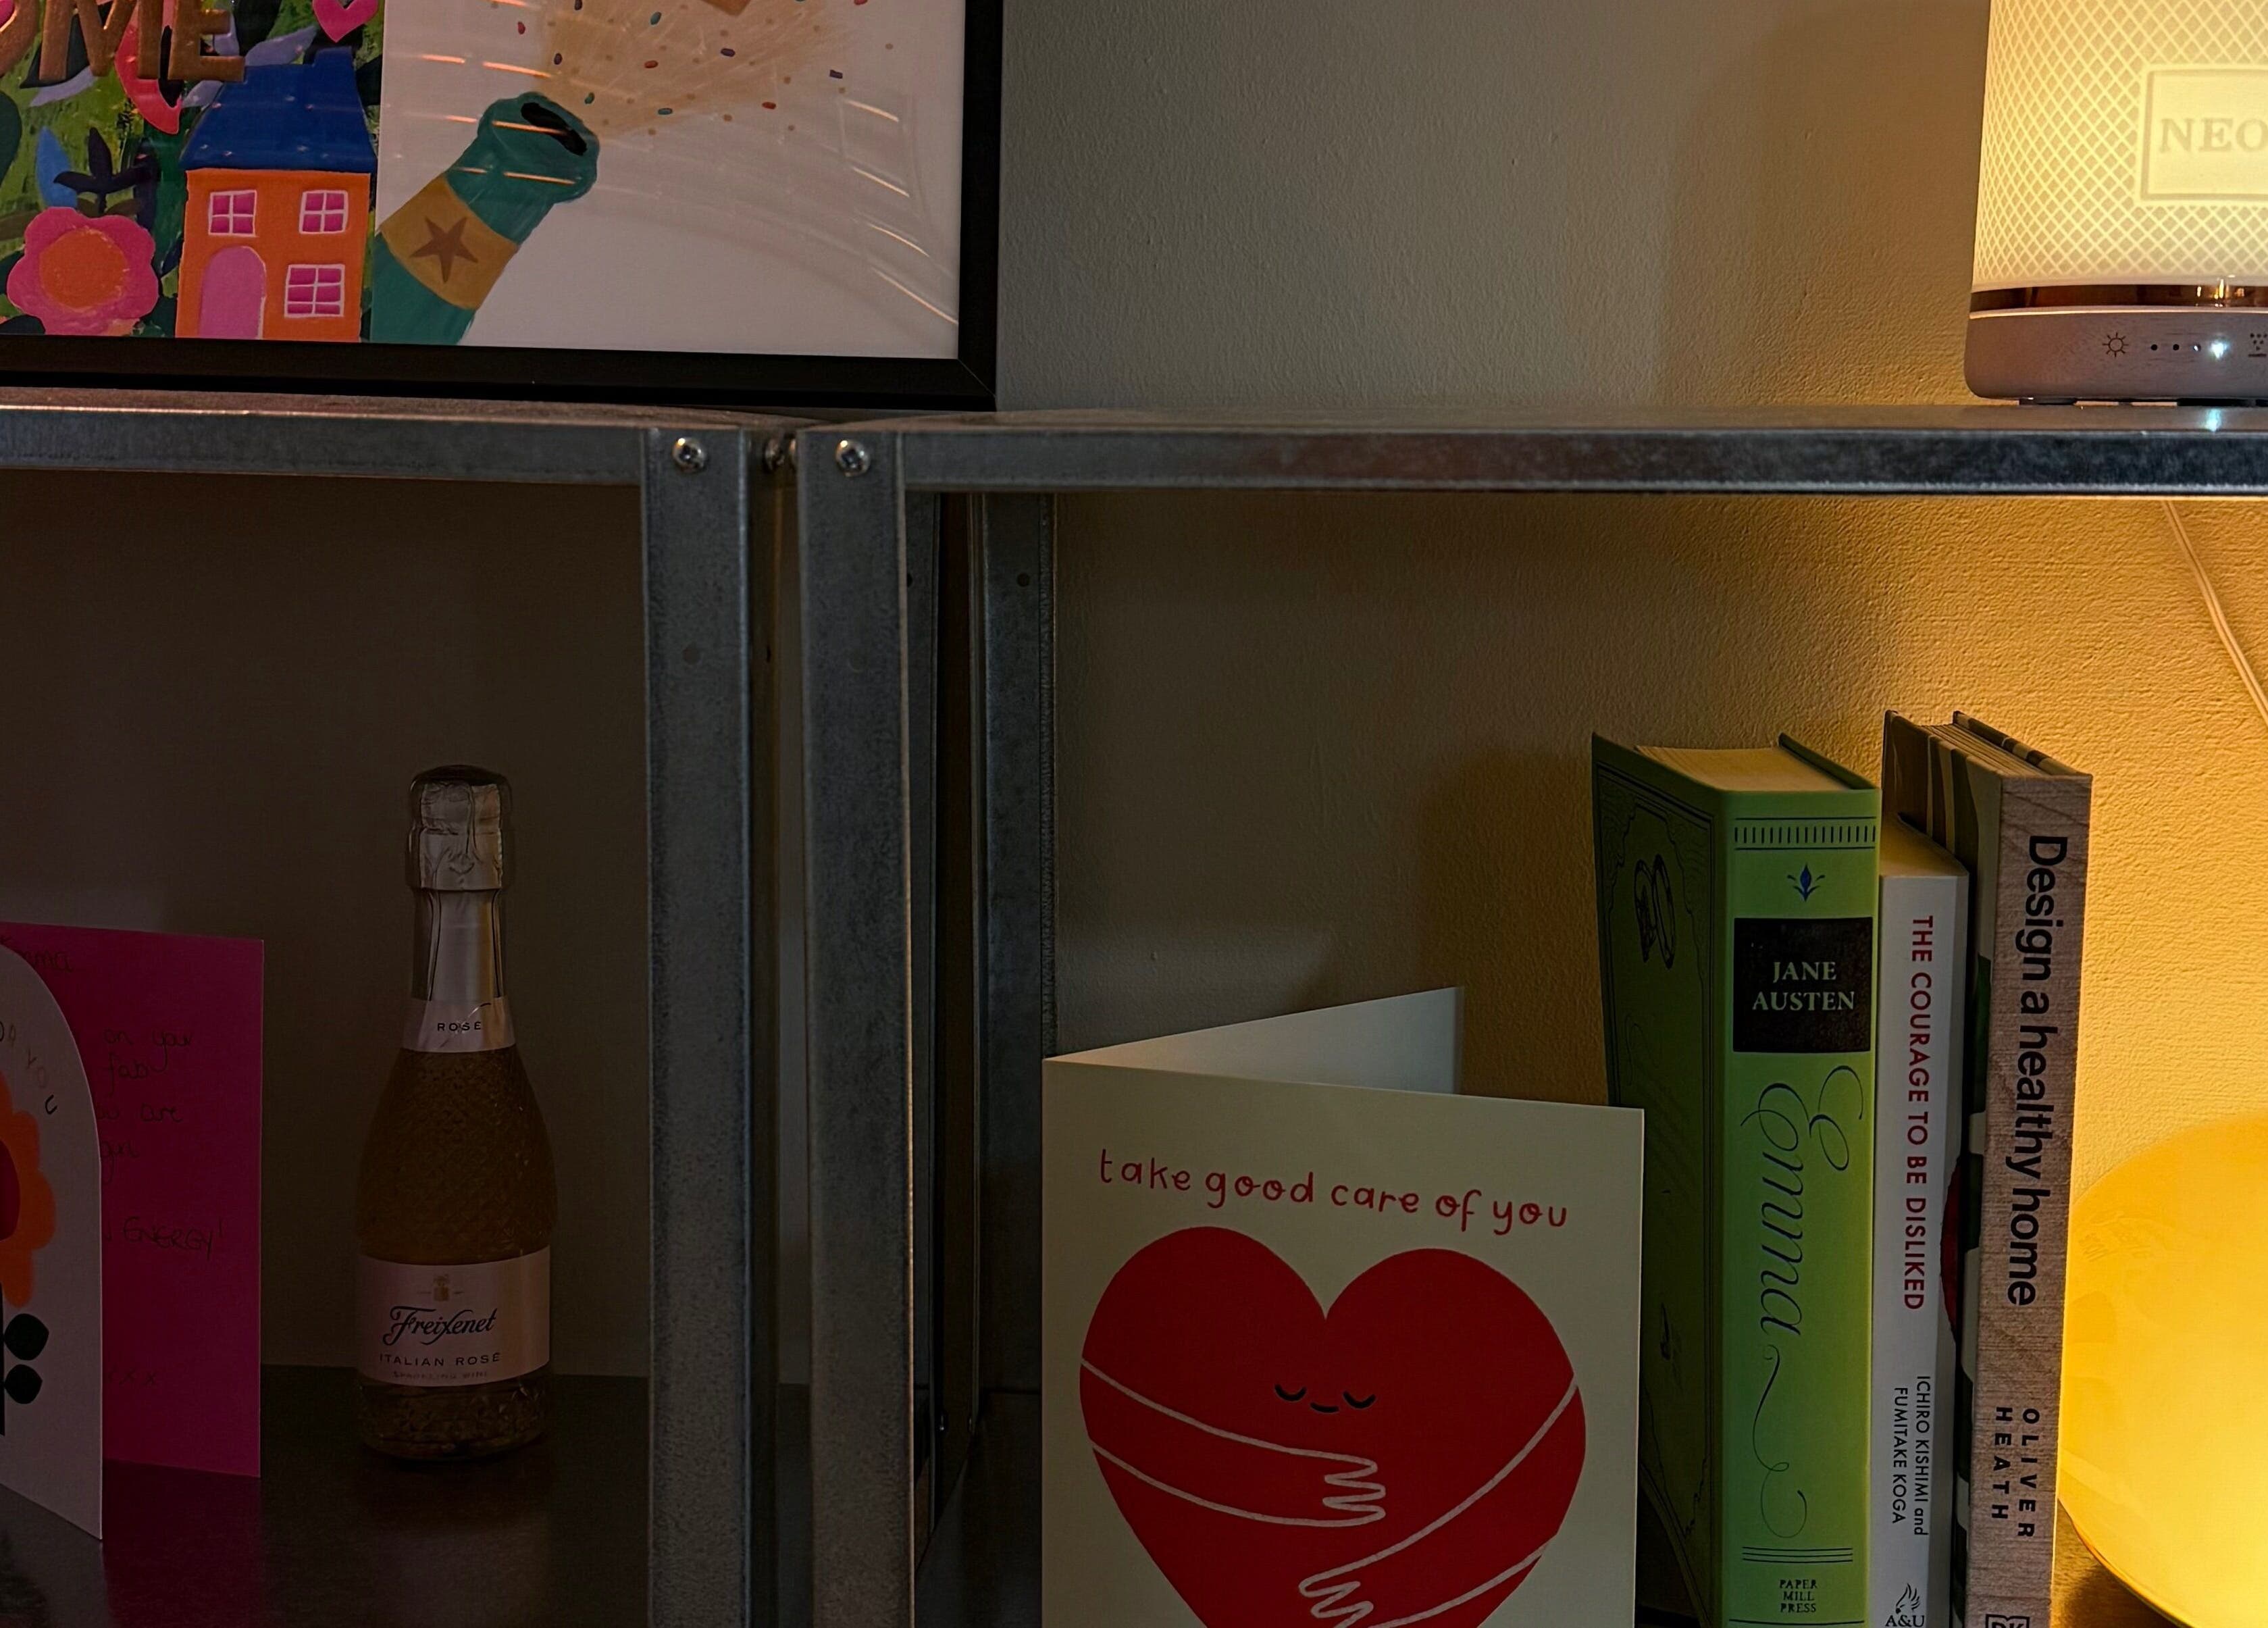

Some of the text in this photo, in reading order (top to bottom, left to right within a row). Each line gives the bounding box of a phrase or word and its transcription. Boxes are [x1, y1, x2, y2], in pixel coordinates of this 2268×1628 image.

[1773, 961, 1837, 984] JANE
[1752, 991, 1855, 1011] AUSTEN
[2005, 836, 2067, 1306] Design a healthy home
[1903, 915, 1933, 1309] THE COURAGE TO BE DISLIKED
[1100, 1149, 1568, 1236] take good care of you
[382, 1306, 498, 1346] Freixenet
[380, 1353, 444, 1367] ITALIAN
[1892, 1388, 1909, 1524] FUMITAKE KOGA
[1913, 1376, 1931, 1535] ICHIRO KISHIMI and
[1992, 1406, 2013, 1519] HEATH
[2017, 1408, 2040, 1537] OLIVER
[1780, 1579, 1818, 1589] PAPER
[1783, 1591, 1815, 1602] MILL
[1780, 1602, 1816, 1613] PRESS
[1885, 1614, 1925, 1628] A&U
